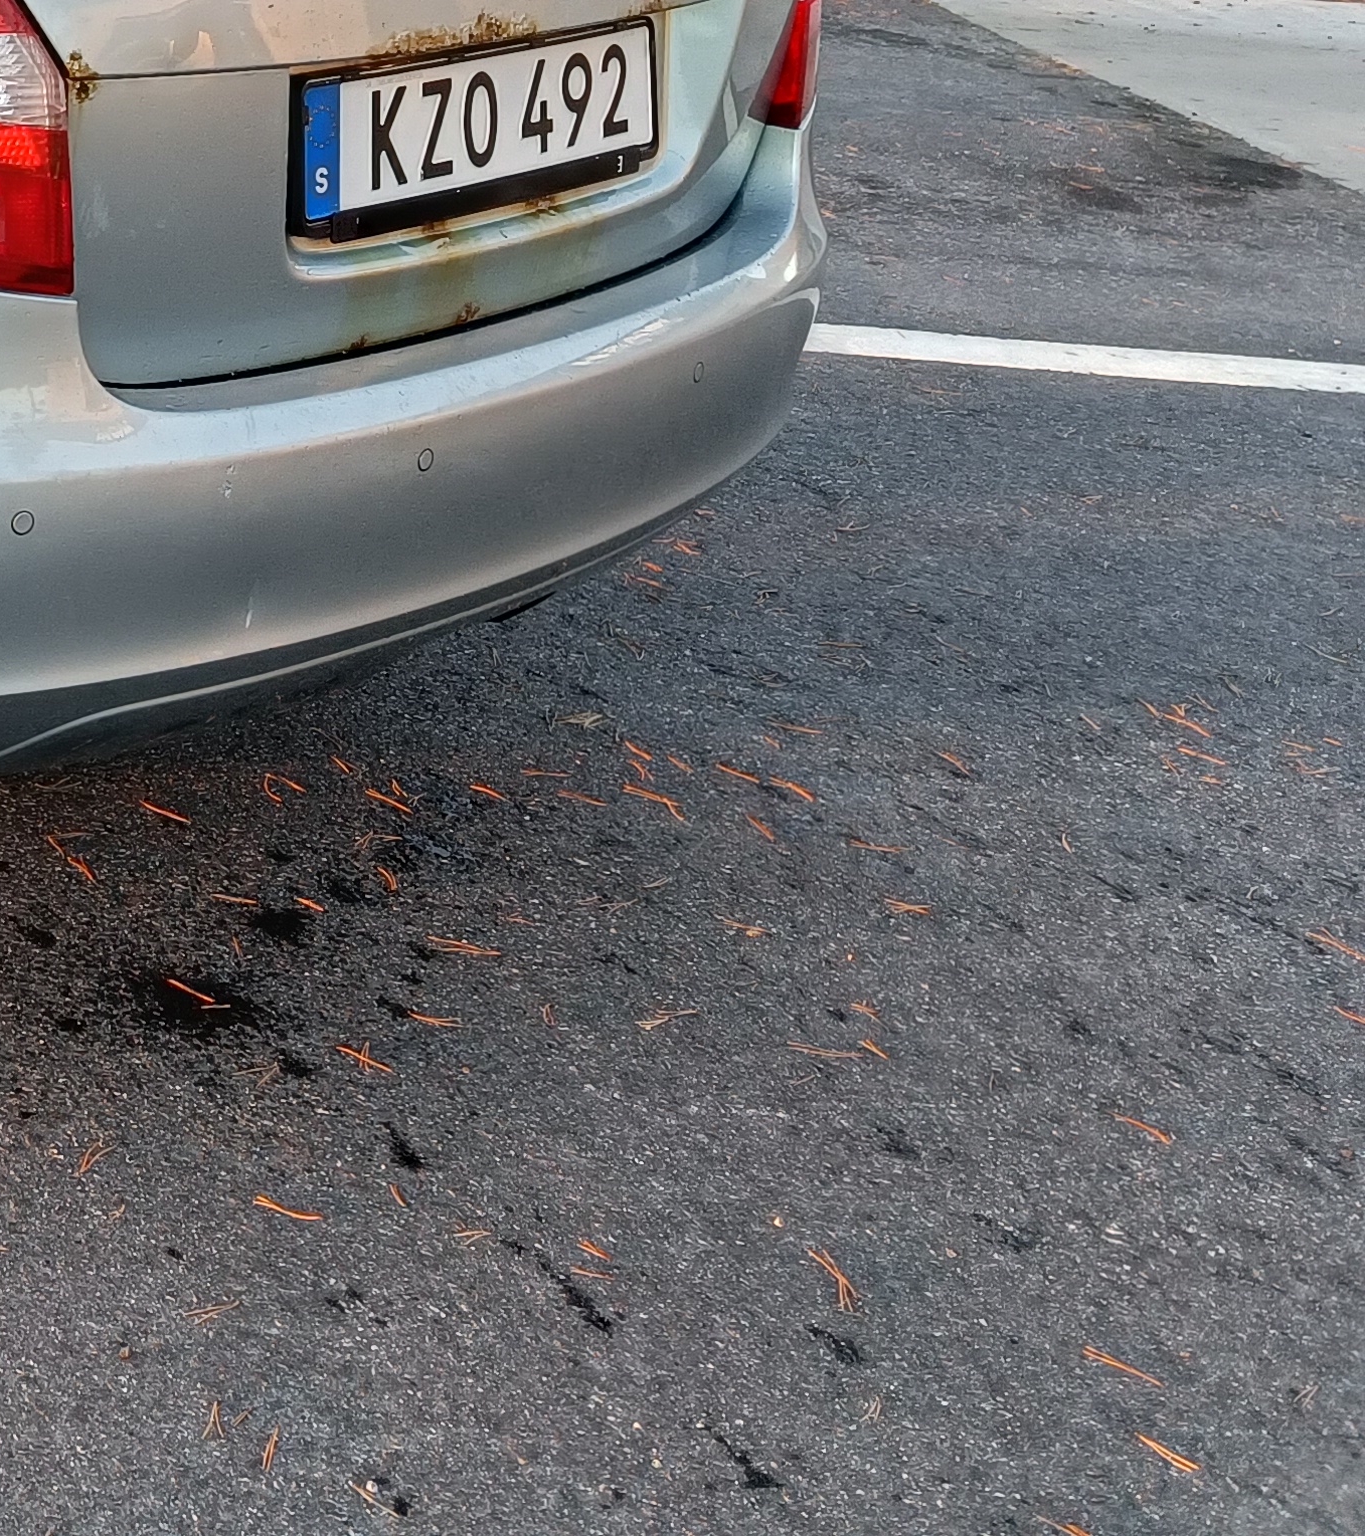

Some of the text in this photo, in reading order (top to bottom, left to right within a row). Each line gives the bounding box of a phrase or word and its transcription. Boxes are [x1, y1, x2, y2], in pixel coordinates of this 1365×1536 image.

[371, 44, 629, 191] KZO 492
[314, 167, 329, 195] S
